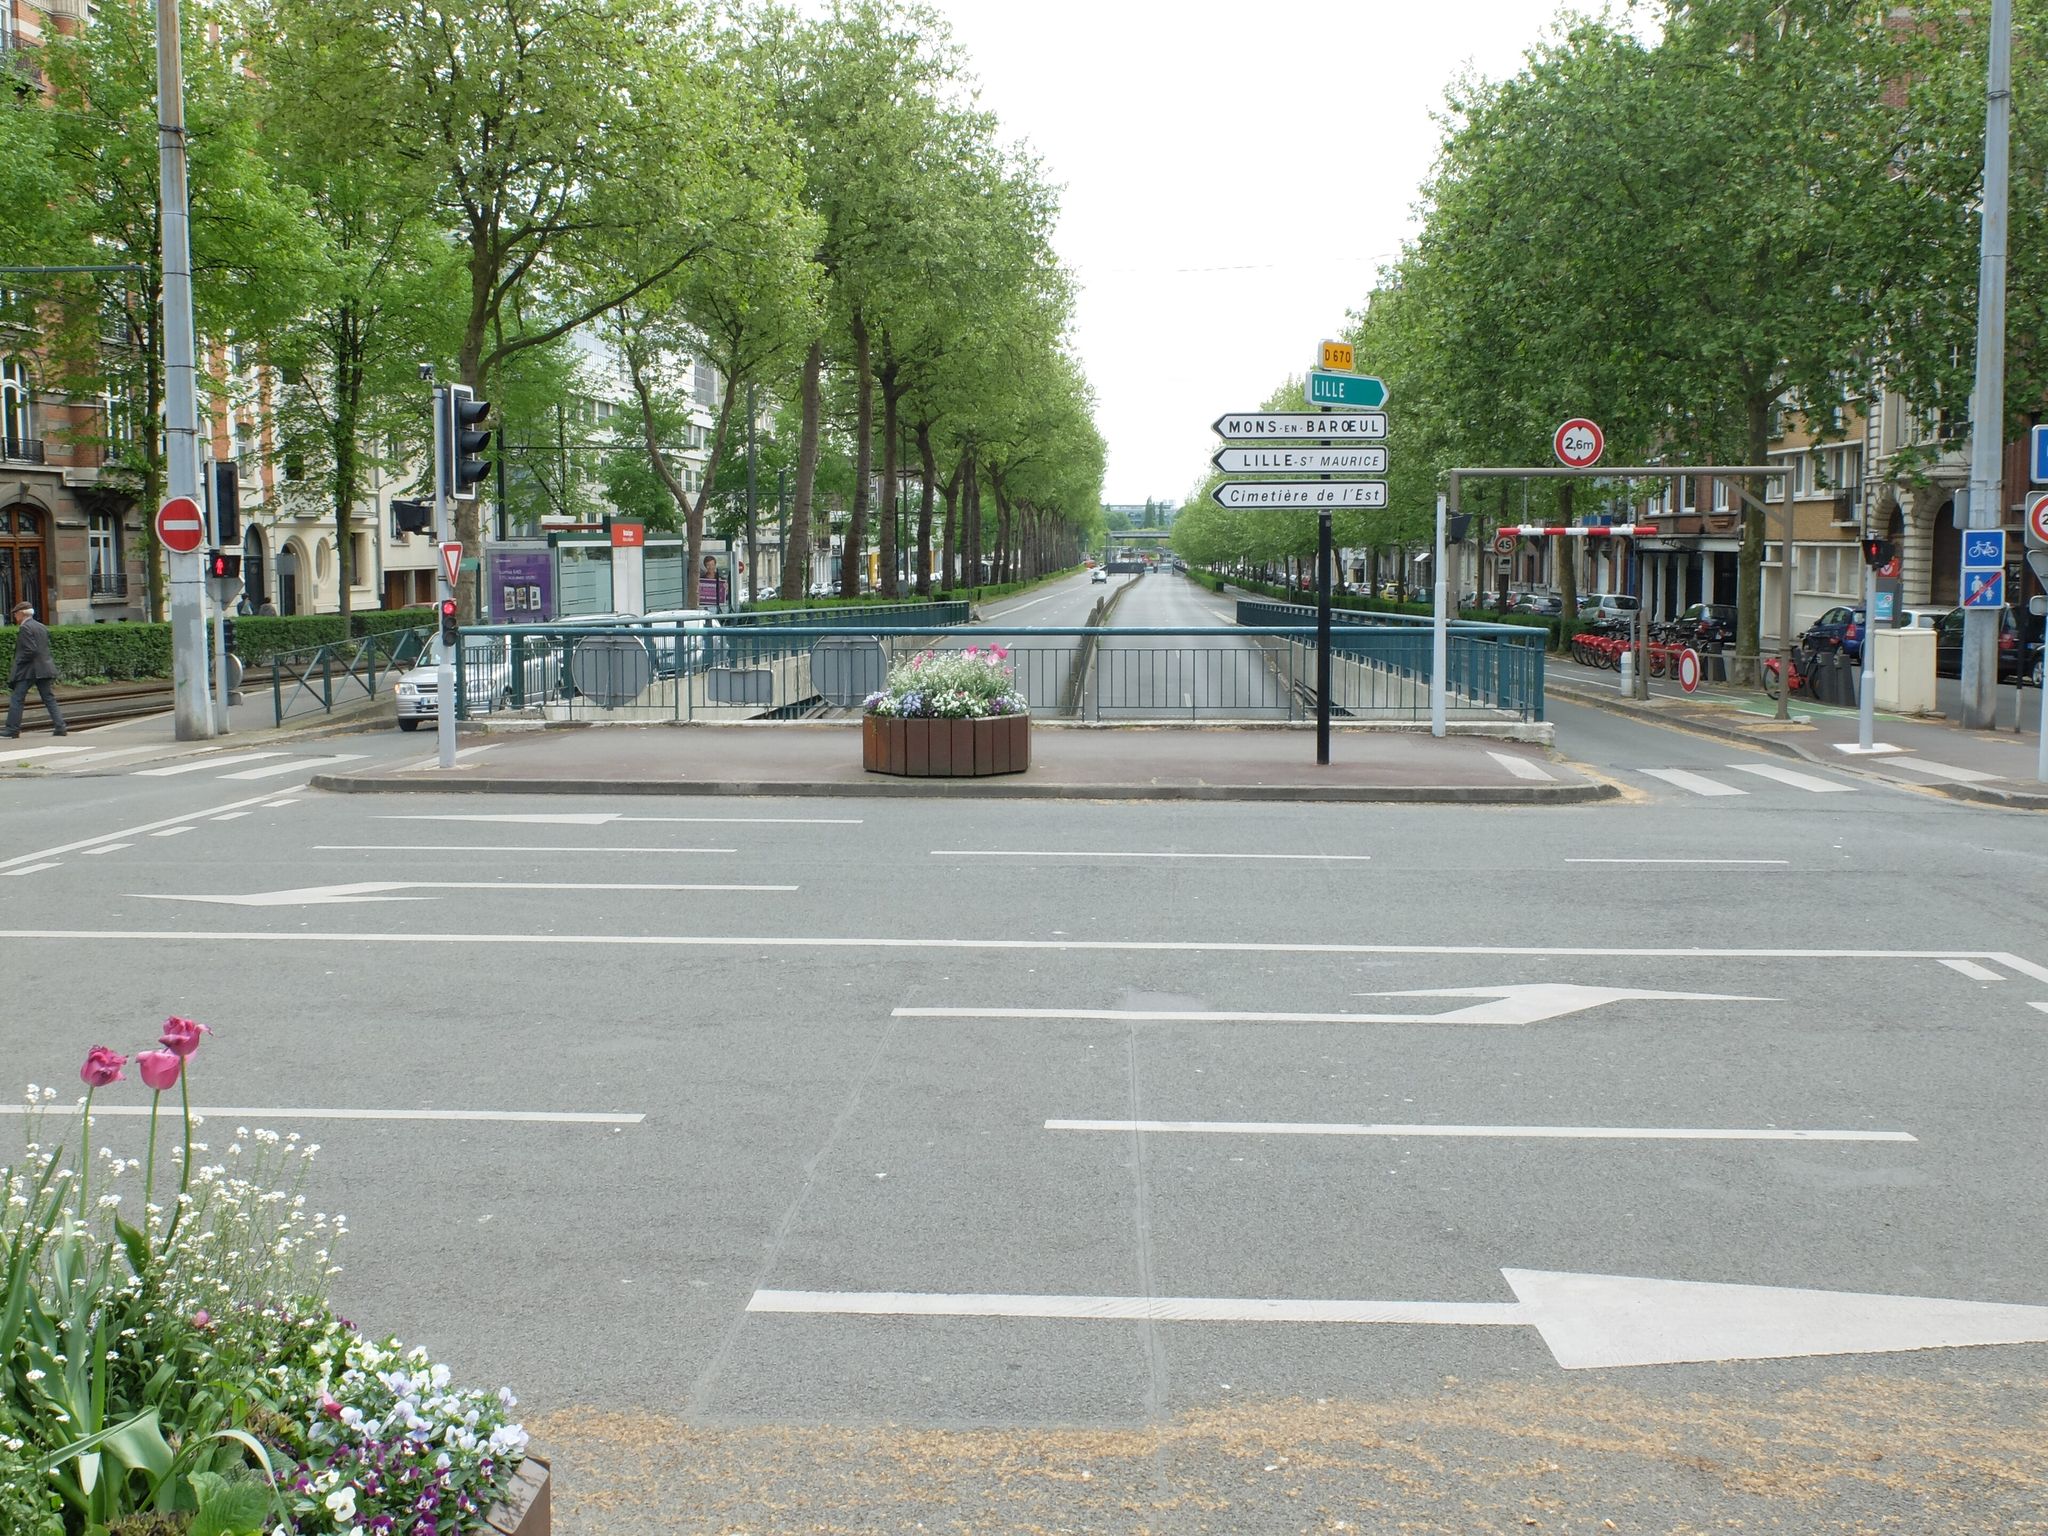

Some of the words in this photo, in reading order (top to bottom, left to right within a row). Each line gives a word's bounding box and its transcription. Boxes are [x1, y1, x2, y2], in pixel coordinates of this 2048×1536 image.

[1325, 349, 1331, 361] D
[1333, 350, 1351, 363] 670
[1314, 380, 1345, 398] LILLE
[1320, 456, 1380, 467] MAURICE
[1230, 489, 1309, 502] Cimetière
[1317, 488, 1334, 501] de
[1343, 488, 1380, 501] l'Est
[1499, 540, 1511, 550] 45
